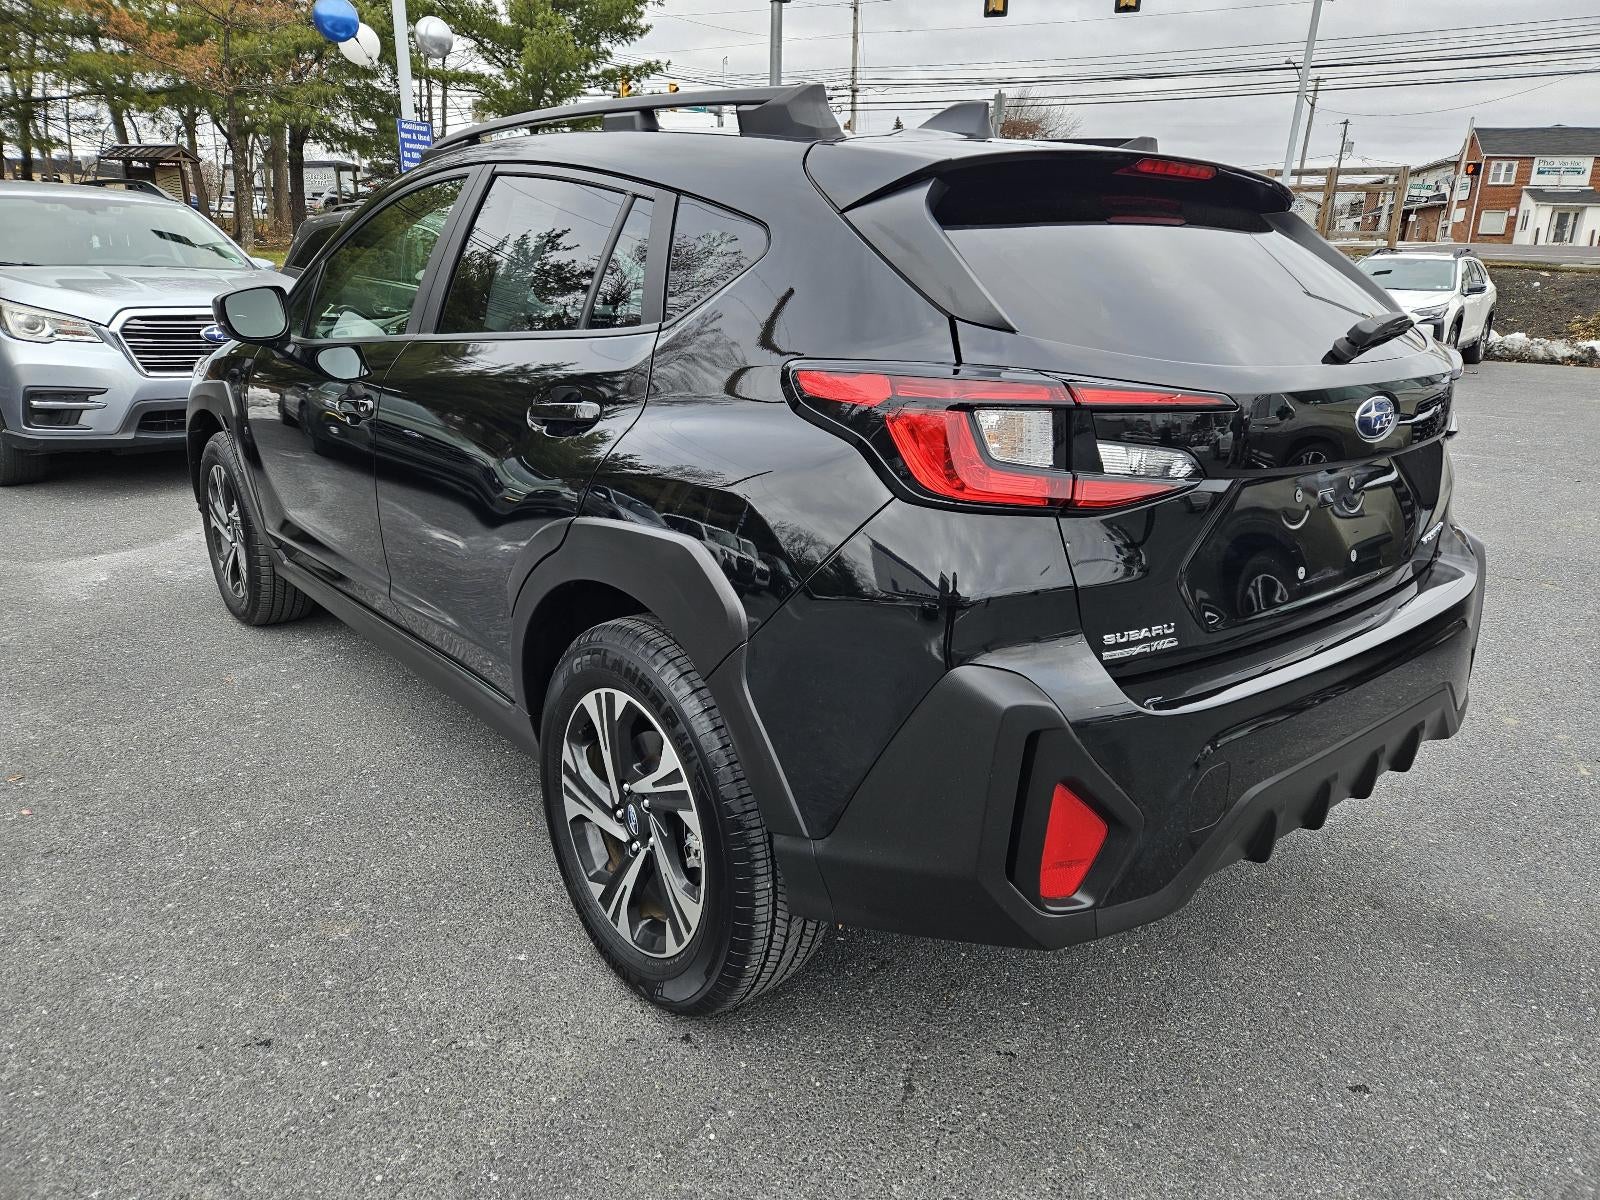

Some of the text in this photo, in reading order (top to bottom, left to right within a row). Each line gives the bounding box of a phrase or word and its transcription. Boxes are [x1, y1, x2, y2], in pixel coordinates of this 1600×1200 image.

[401, 122, 427, 131] Additional
[417, 134, 430, 142] Used
[1103, 622, 1175, 645] SUBARU
